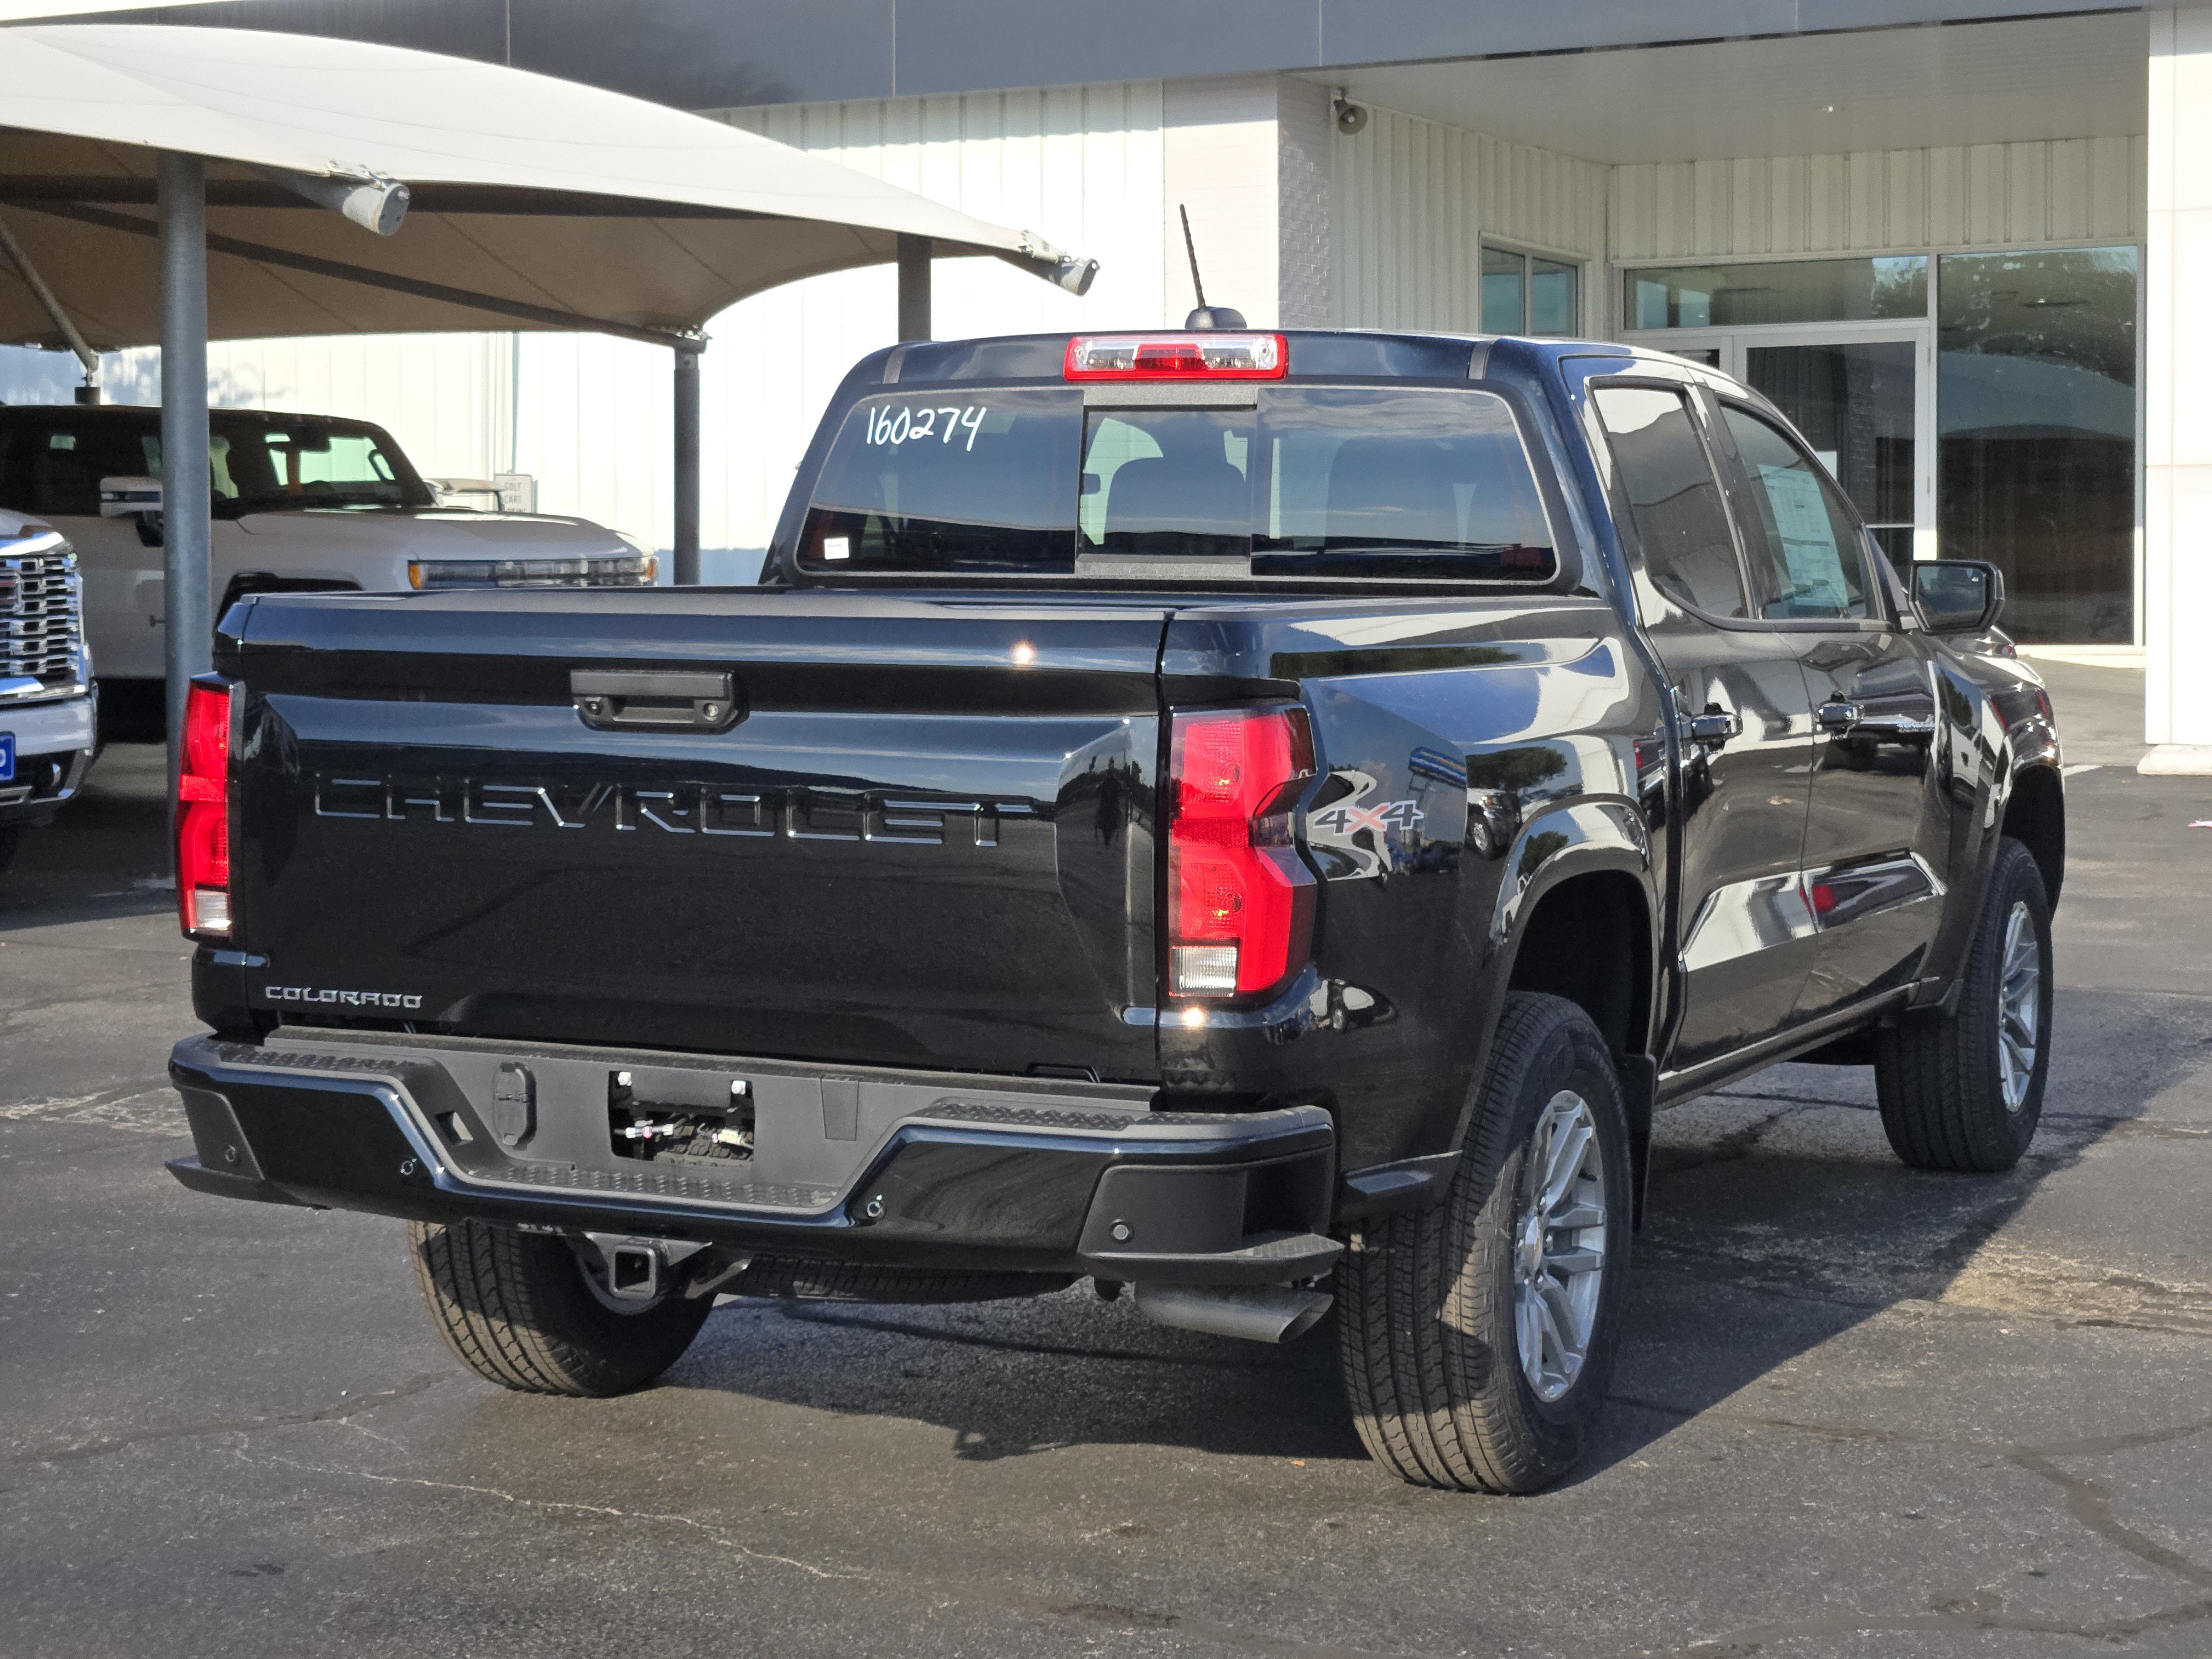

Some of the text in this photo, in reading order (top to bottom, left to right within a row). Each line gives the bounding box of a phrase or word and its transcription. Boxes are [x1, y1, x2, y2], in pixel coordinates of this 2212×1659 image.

[867, 405, 987, 451] 160274
[313, 772, 1033, 847] CHEVROLET
[265, 985, 422, 1009] COLORADO
